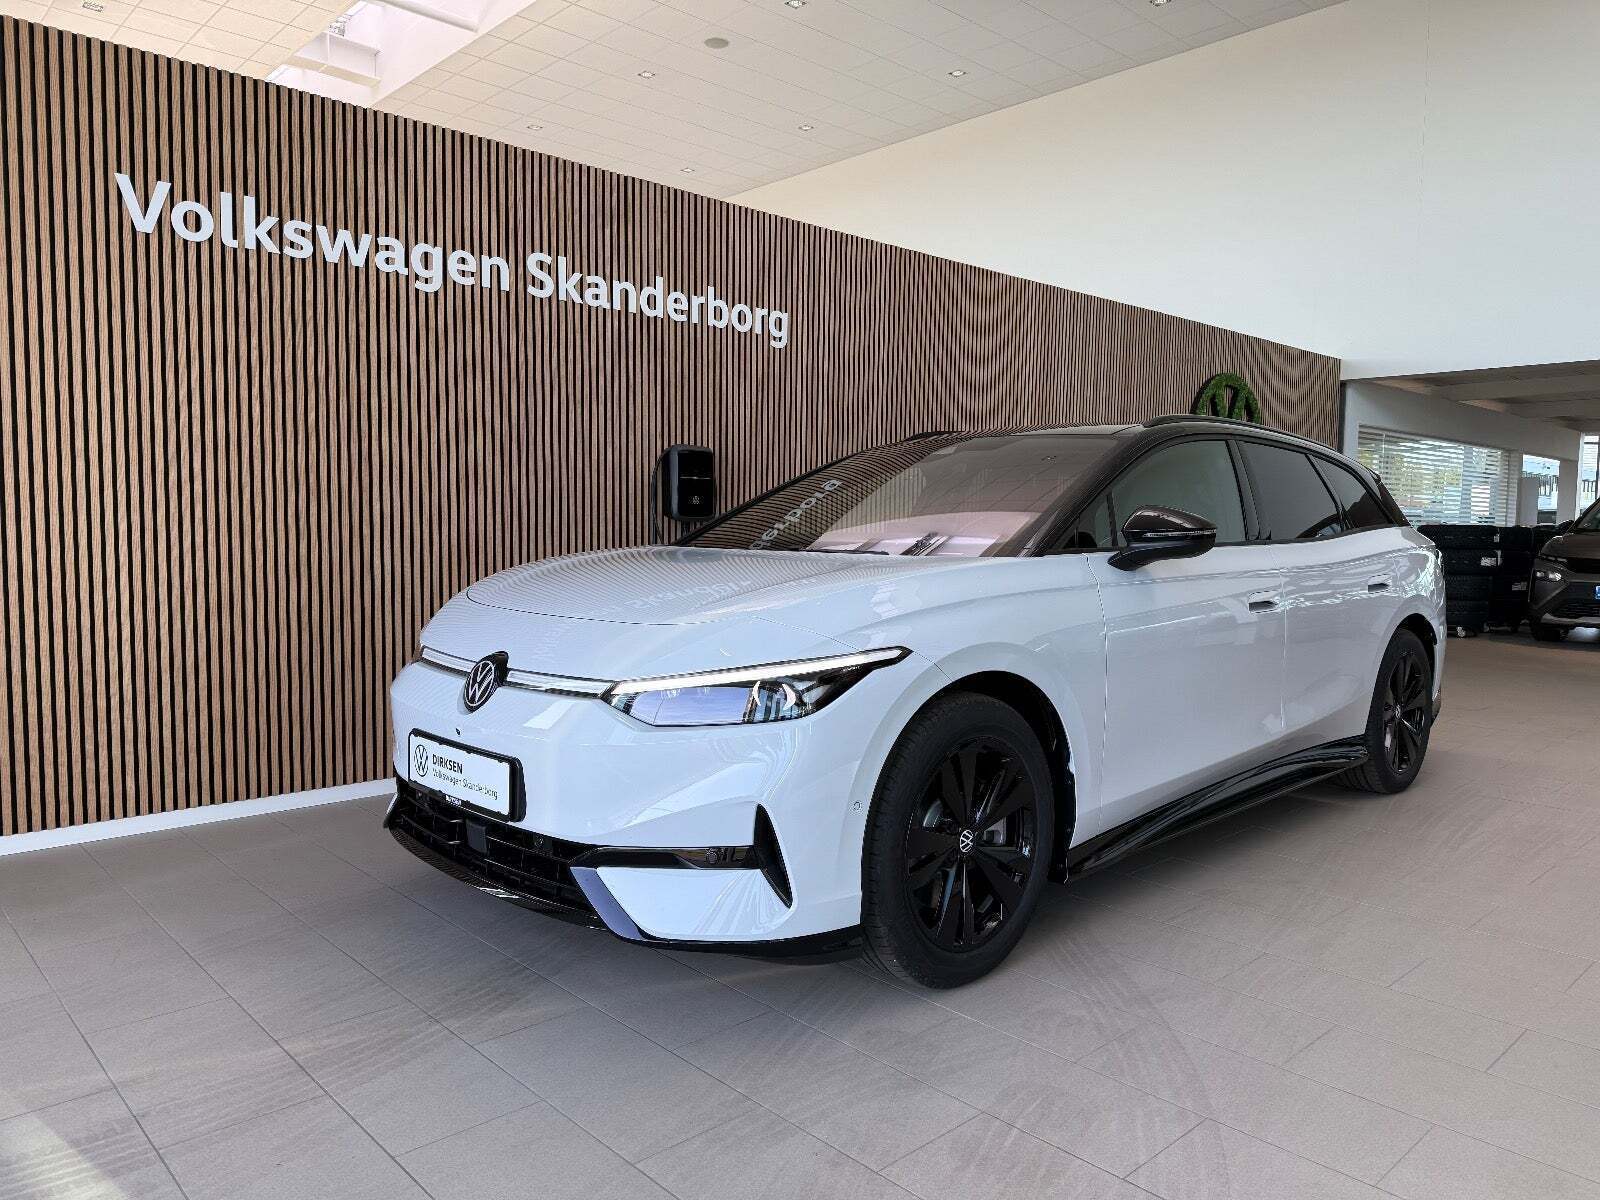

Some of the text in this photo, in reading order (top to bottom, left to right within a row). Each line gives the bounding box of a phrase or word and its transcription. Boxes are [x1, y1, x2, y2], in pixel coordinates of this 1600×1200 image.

[114, 172, 790, 349] Volkswagen Skanderborg
[432, 754, 463, 775] DIRKSEN
[432, 768, 462, 786] Volkswagen
[463, 778, 498, 801] Skanderborg
